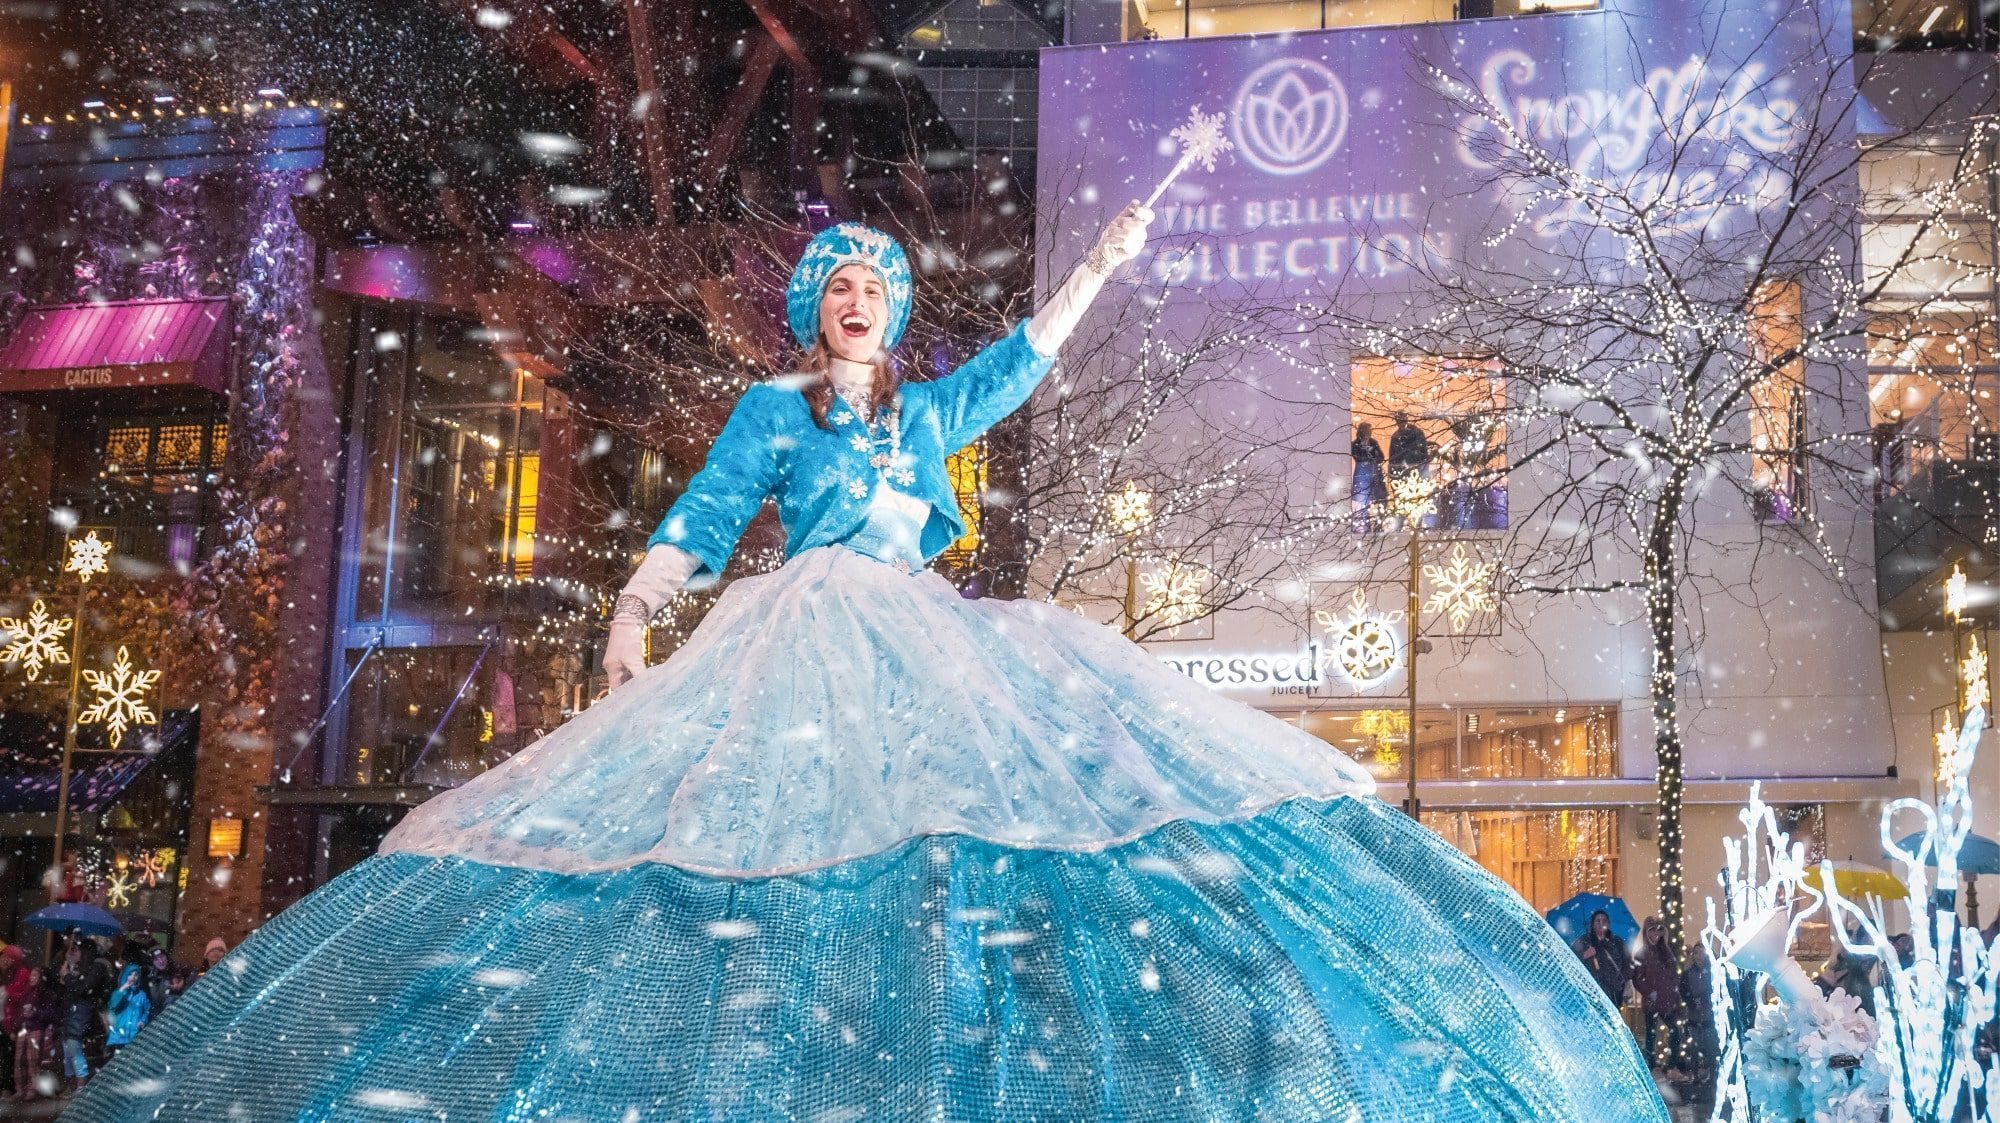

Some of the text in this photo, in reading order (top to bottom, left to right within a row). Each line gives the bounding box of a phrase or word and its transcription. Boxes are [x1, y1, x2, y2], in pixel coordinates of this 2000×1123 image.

[1456, 50, 1797, 170] Snowflake
[1156, 193, 1415, 232] THE BELLEVUE
[64, 368, 112, 386] CACTUS
[1271, 685, 1319, 695] JUICERY
